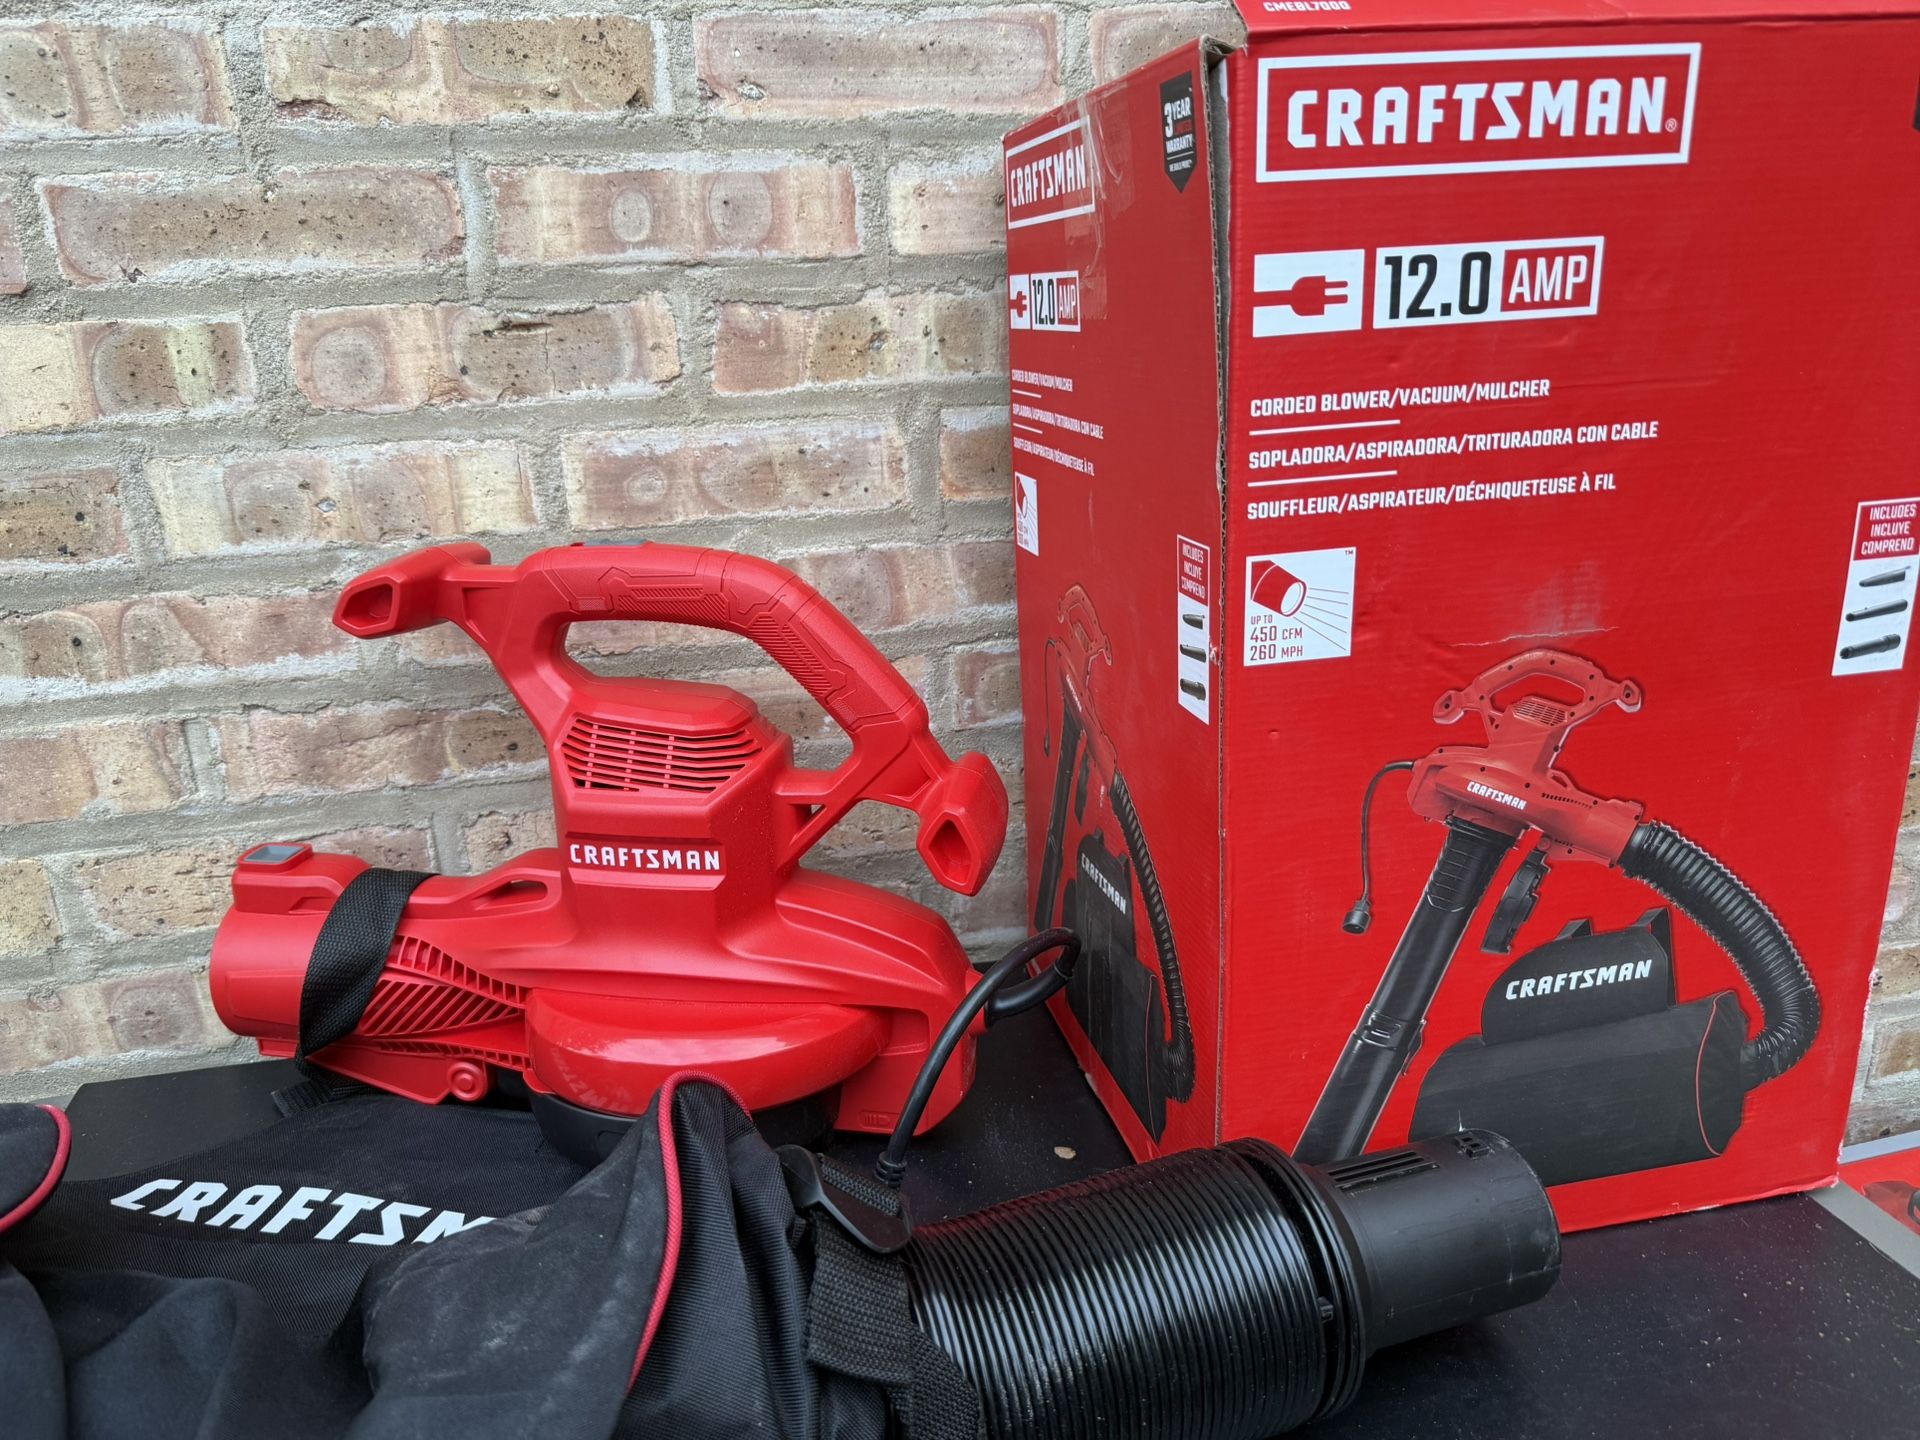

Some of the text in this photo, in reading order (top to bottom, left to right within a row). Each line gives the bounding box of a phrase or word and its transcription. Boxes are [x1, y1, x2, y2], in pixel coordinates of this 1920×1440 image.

[1263, 0, 1351, 11] CMEBL7000
[1164, 102, 1174, 138] 3
[1172, 97, 1192, 120] YEAR
[1010, 145, 1086, 208] CRAFTSMAN
[1033, 278, 1076, 325] 12.0 AMP
[1385, 250, 1588, 320] 12.0 AMP
[1250, 379, 1551, 417] CORDED BLOWER/VACUUM/MULCHER
[1248, 421, 1659, 469] SOPLADORA/ASPIRADORA/TRITURADORA CON CABLE
[1247, 472, 1616, 520] SOUFFLEUR/ASPIRATEUR/DÉCHIQUETEUSE À FIL
[1869, 504, 1916, 519] INCLUDES
[1871, 521, 1910, 536] INCLUYE
[1862, 538, 1914, 554] COMPREND
[1250, 625, 1303, 643] 450 CFM
[1251, 614, 1273, 625] UP TO
[1250, 643, 1303, 661] 260 MPH
[1467, 781, 1527, 810] CRAFTSMAN
[570, 843, 720, 871] CRAFTSMAN
[1081, 853, 1126, 915] CRAFTSMAN
[1505, 959, 1653, 1001] CRAFTSMAN
